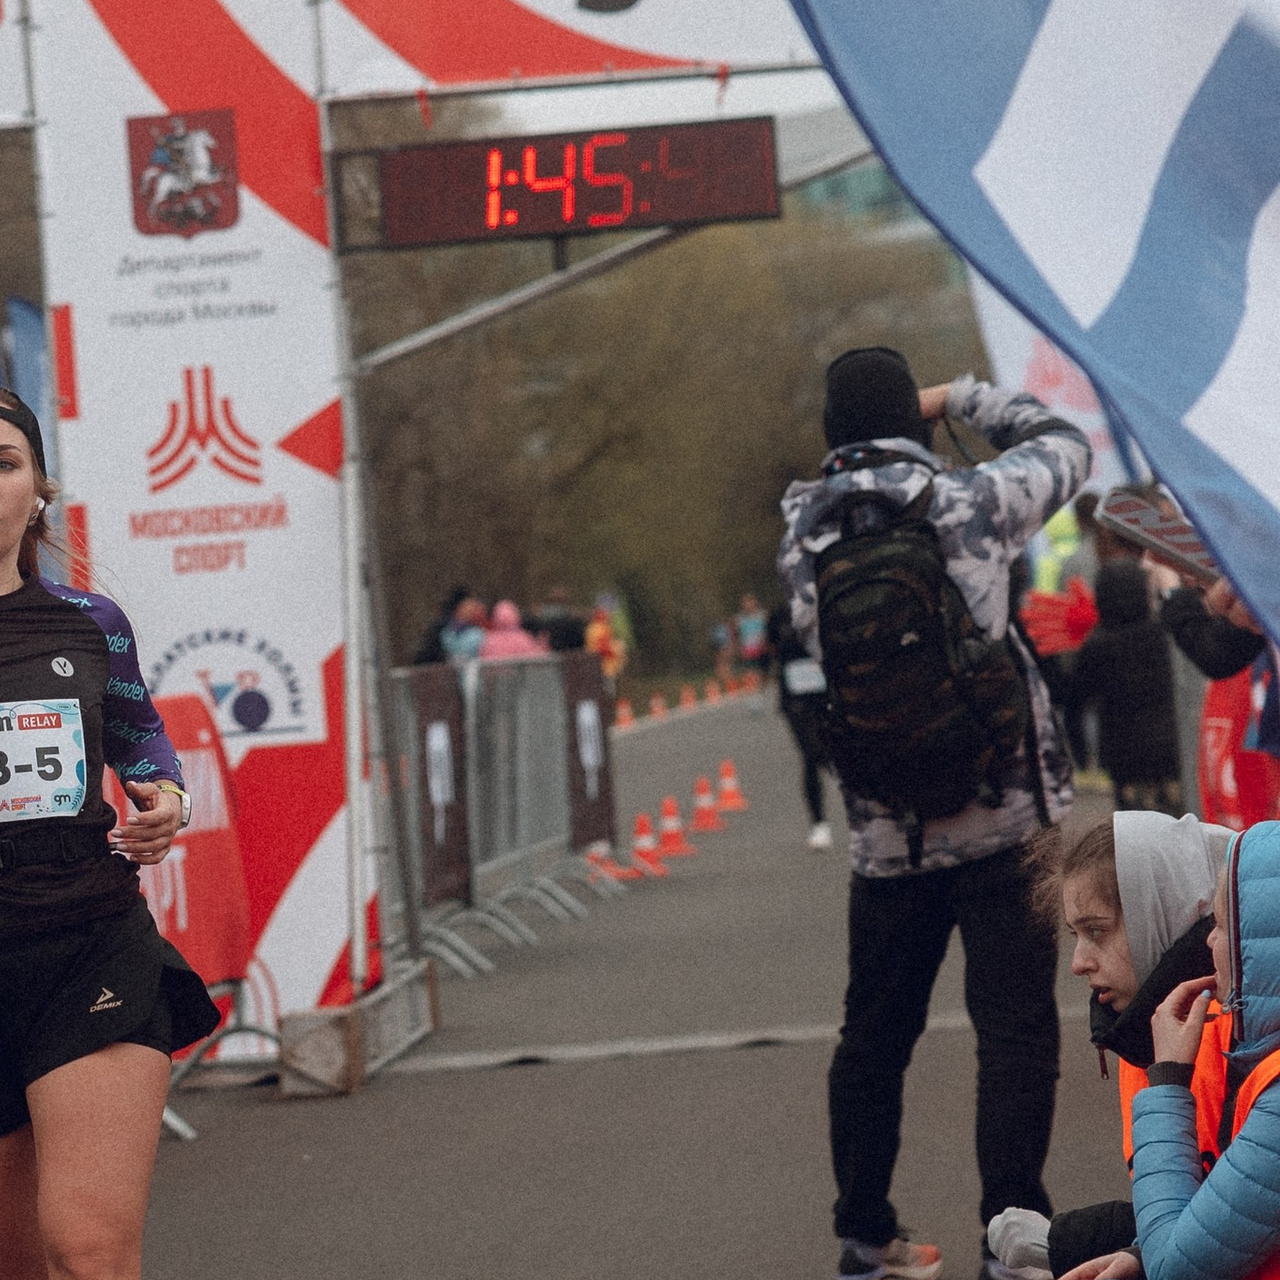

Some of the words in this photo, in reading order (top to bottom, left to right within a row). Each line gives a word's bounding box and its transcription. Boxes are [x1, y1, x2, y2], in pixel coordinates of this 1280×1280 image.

[107, 676, 145, 703] Yandex
[22, 717, 58, 729] RELAY
[54, 794, 71, 806] gm
[89, 1000, 123, 1013] DEMIX
